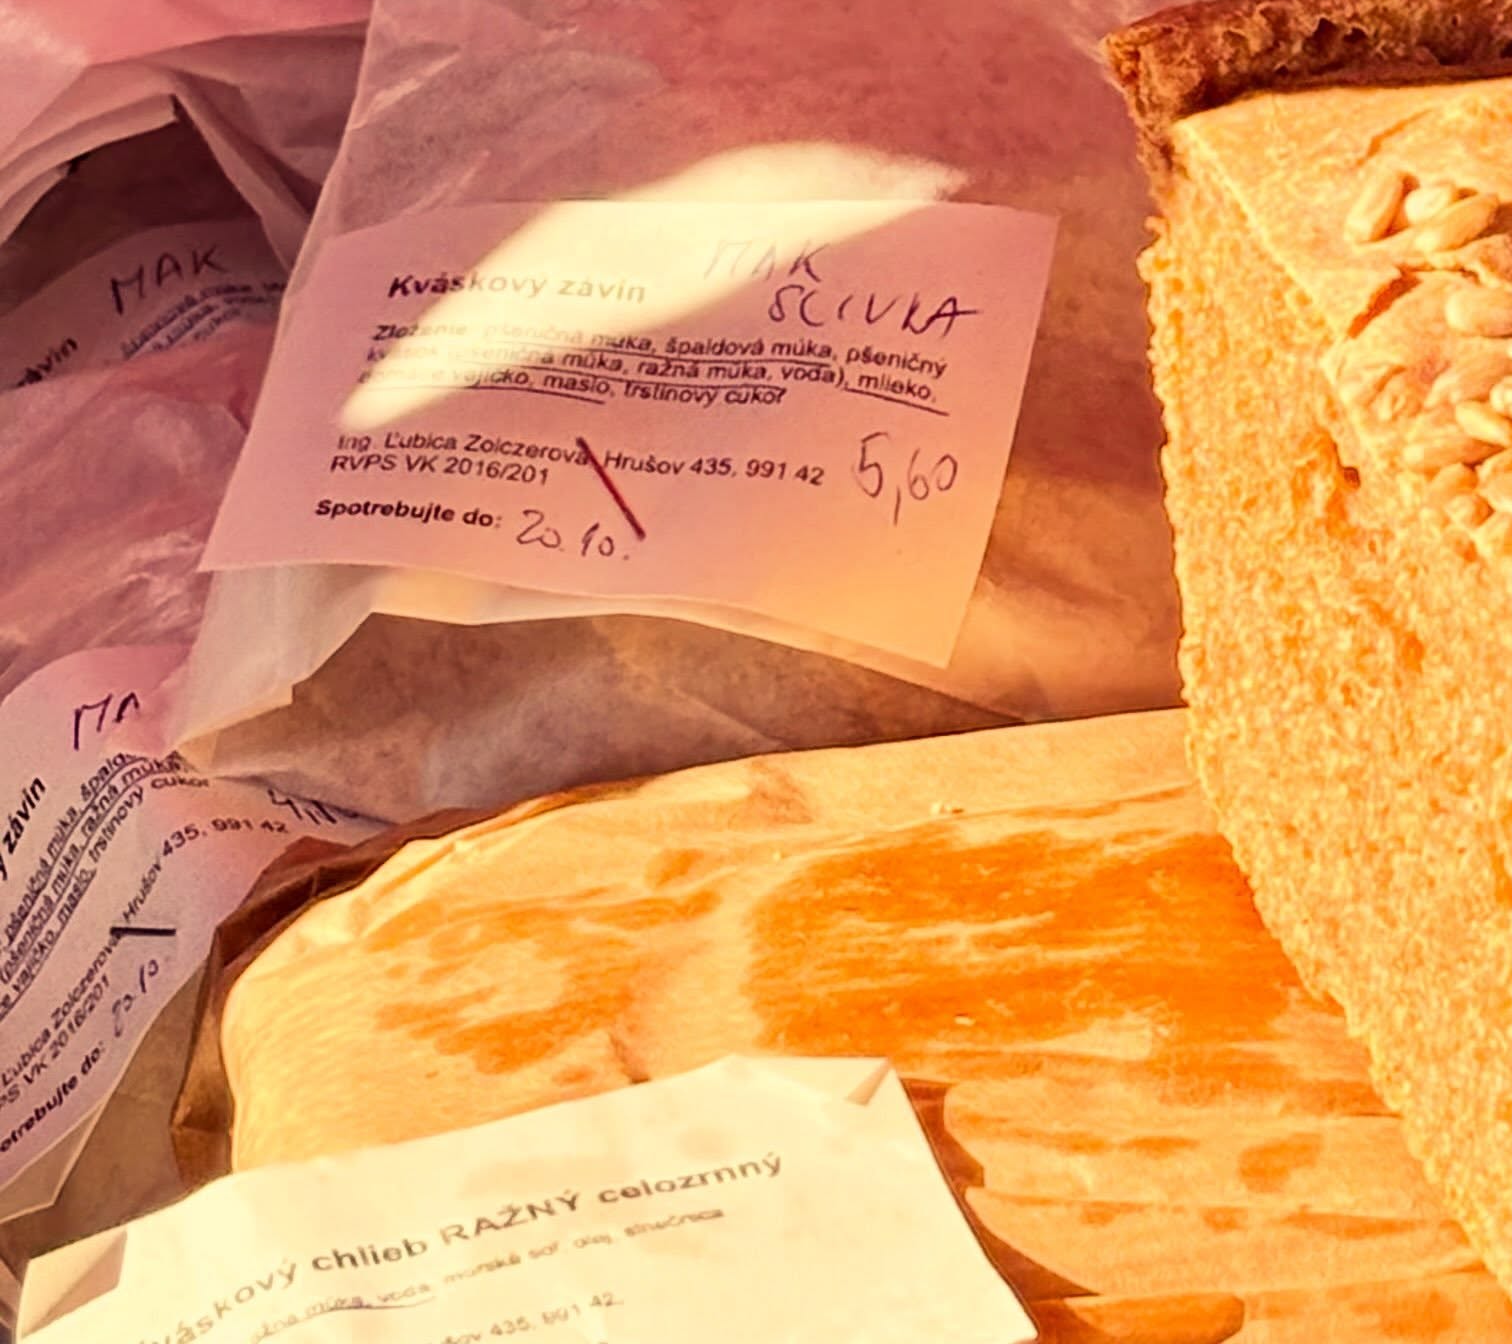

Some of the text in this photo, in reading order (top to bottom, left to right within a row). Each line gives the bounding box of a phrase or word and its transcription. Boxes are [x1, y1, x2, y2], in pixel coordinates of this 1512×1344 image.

[110, 244, 228, 315] MAK
[387, 268, 548, 300] Kváskový
[637, 359, 700, 379] ražná
[845, 346, 948, 379] pšeničný
[329, 453, 550, 486] RVPS VK 2016/201
[603, 449, 686, 476] Hrušov
[744, 458, 788, 482] 991
[793, 463, 826, 487] 42
[856, 430, 960, 527] 5,60
[314, 498, 502, 528] Spotrebujte do:
[2, 777, 47, 856] závin
[311, 1237, 428, 1272] chlieb
[439, 1189, 581, 1246] RAŽNÝ
[597, 1151, 783, 1205] celozrnný
